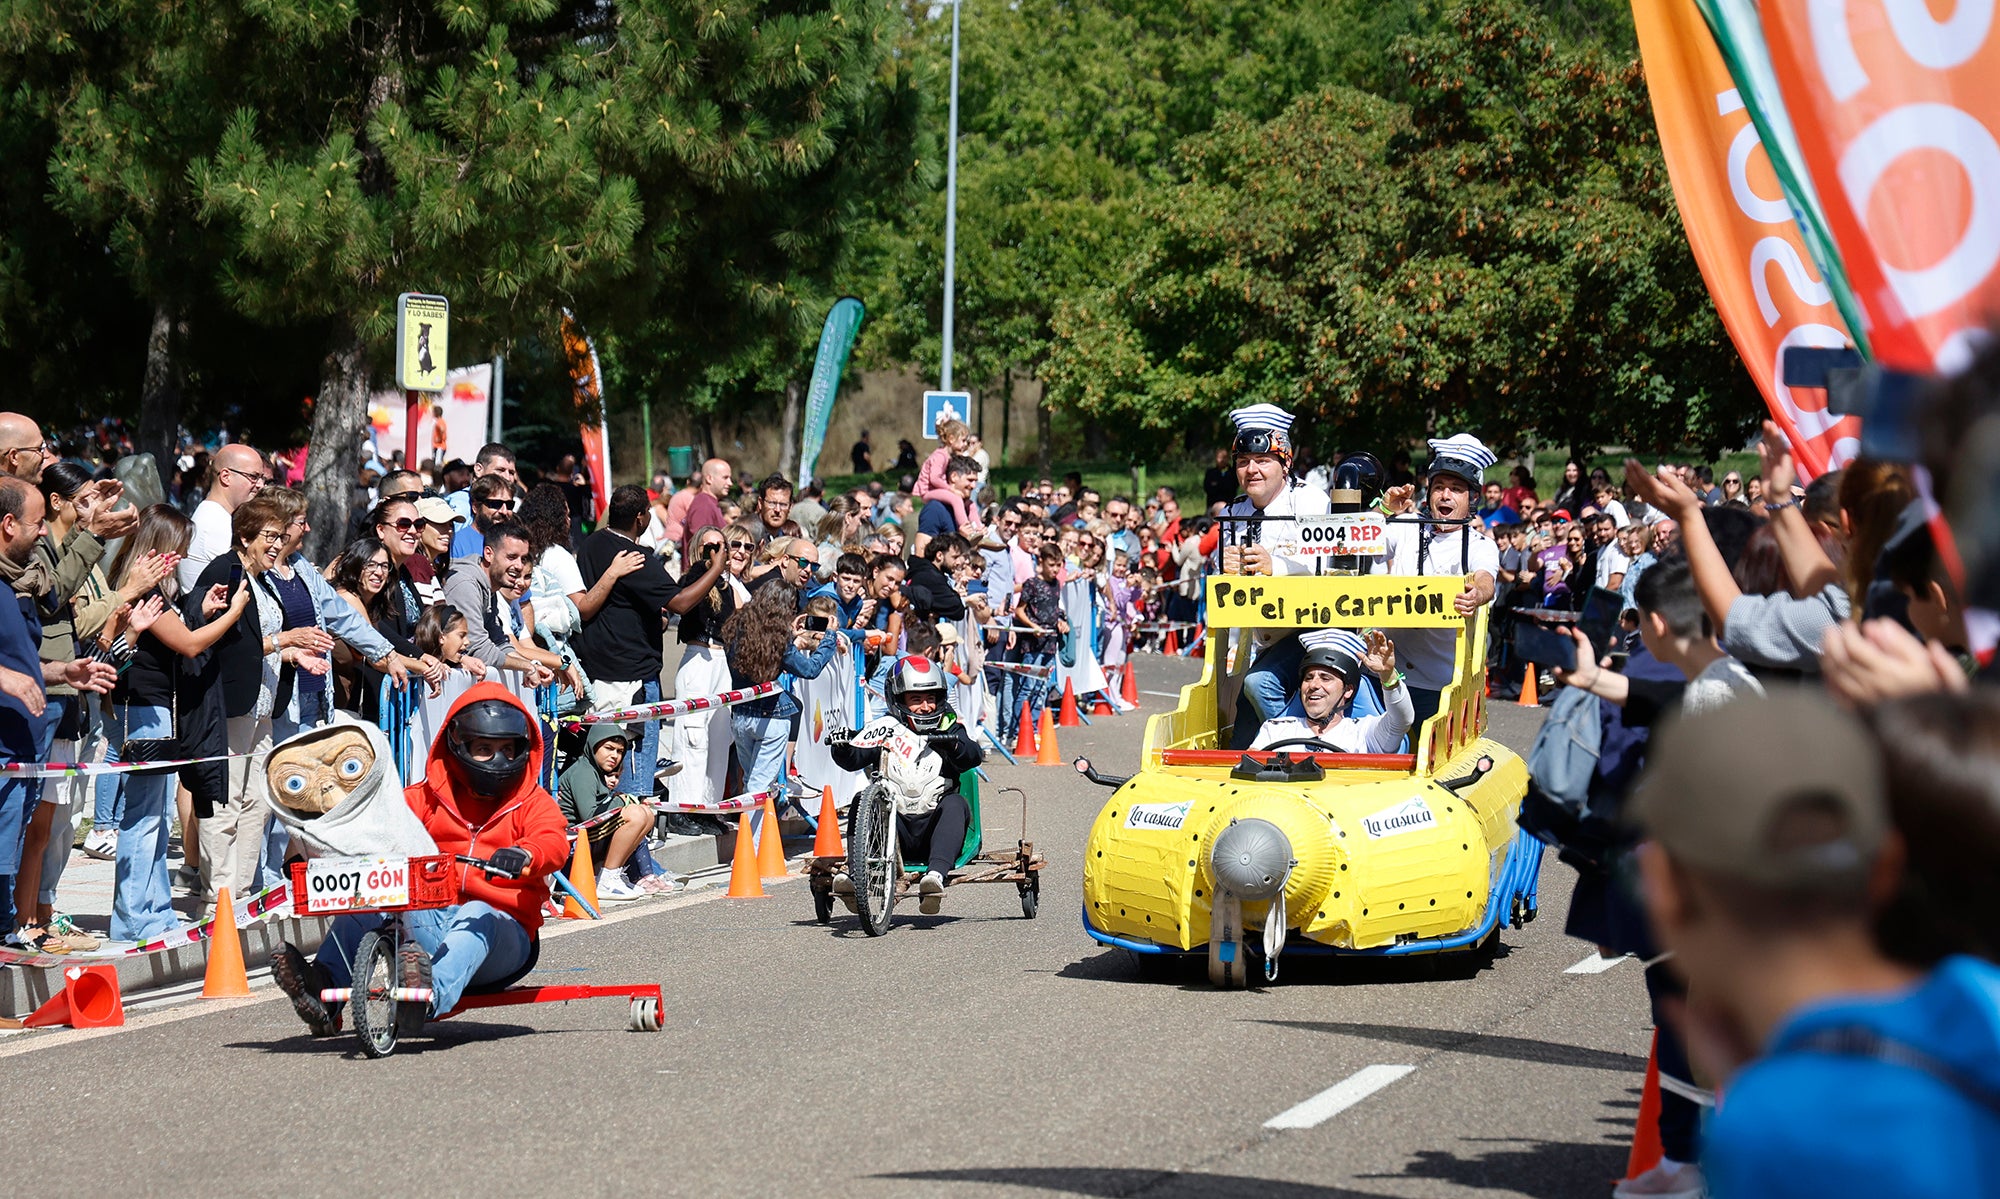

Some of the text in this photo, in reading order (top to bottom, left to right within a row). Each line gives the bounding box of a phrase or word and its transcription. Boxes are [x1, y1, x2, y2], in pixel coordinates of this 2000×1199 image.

[1301, 525, 1382, 542] 0004 REP
[1214, 582, 1264, 608] Por
[1260, 597, 1285, 620] el
[1295, 602, 1331, 625] rio
[863, 726, 895, 740] 0003
[895, 736, 913, 759] CIA
[1129, 805, 1183, 829] La casuca
[1363, 810, 1432, 837] La casuca
[312, 866, 404, 893] 0007 GÓN
